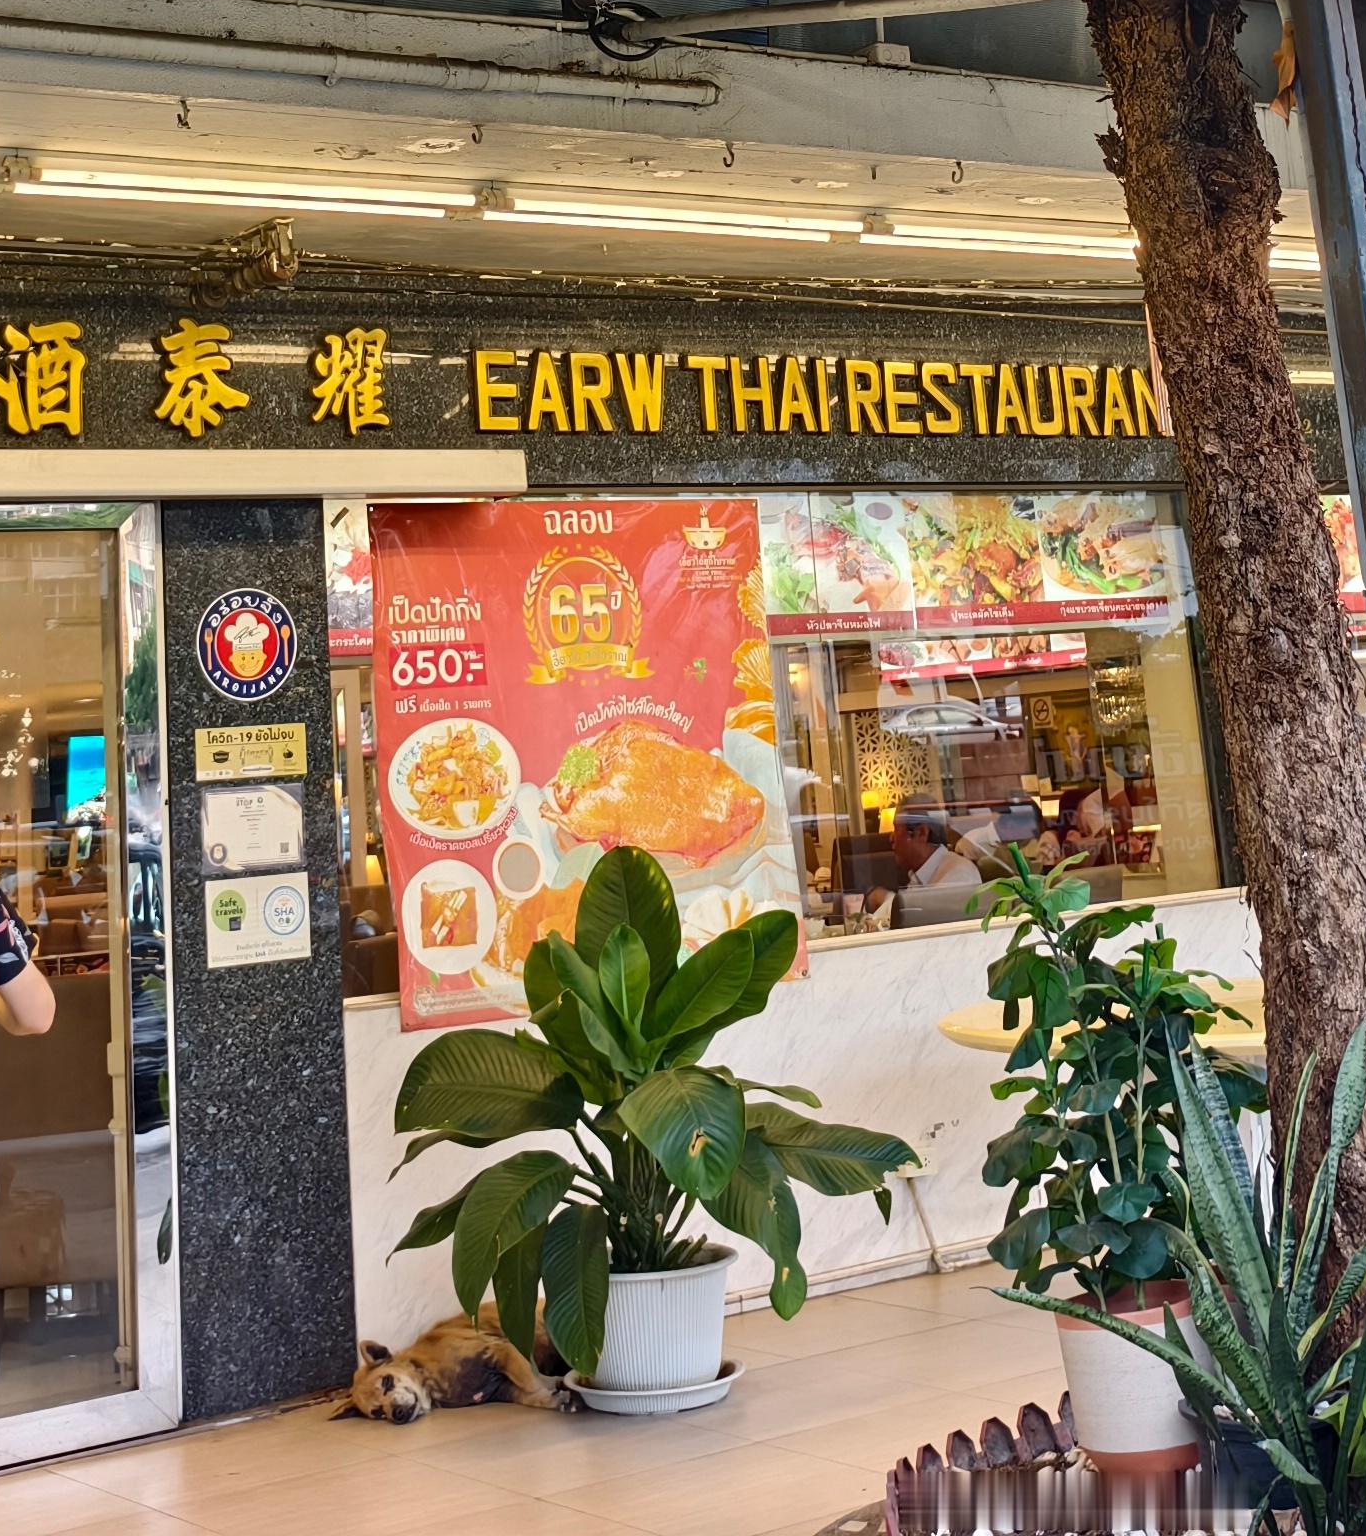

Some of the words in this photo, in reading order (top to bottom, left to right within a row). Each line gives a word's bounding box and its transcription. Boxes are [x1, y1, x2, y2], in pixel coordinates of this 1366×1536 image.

[473, 348, 664, 433] EARW
[682, 353, 833, 435] THAI
[842, 358, 1172, 438] RESTAURAN
[543, 509, 614, 536] ฉลอง
[388, 588, 482, 625] เป็ดปักกิ่ง
[549, 583, 610, 645] 65
[806, 615, 881, 631] หัวปลาจีนหม้อไฟ
[391, 625, 466, 645] ราคาพิเศษ
[212, 667, 284, 694] AROIJANG
[395, 694, 417, 714] ฟรี
[463, 698, 492, 710] รายการ
[206, 731, 253, 744] โควิด-19
[255, 727, 295, 741] ยังไม่จบ
[215, 906, 244, 916] travels
[219, 898, 238, 907] Safe
[274, 907, 295, 917] SHA
